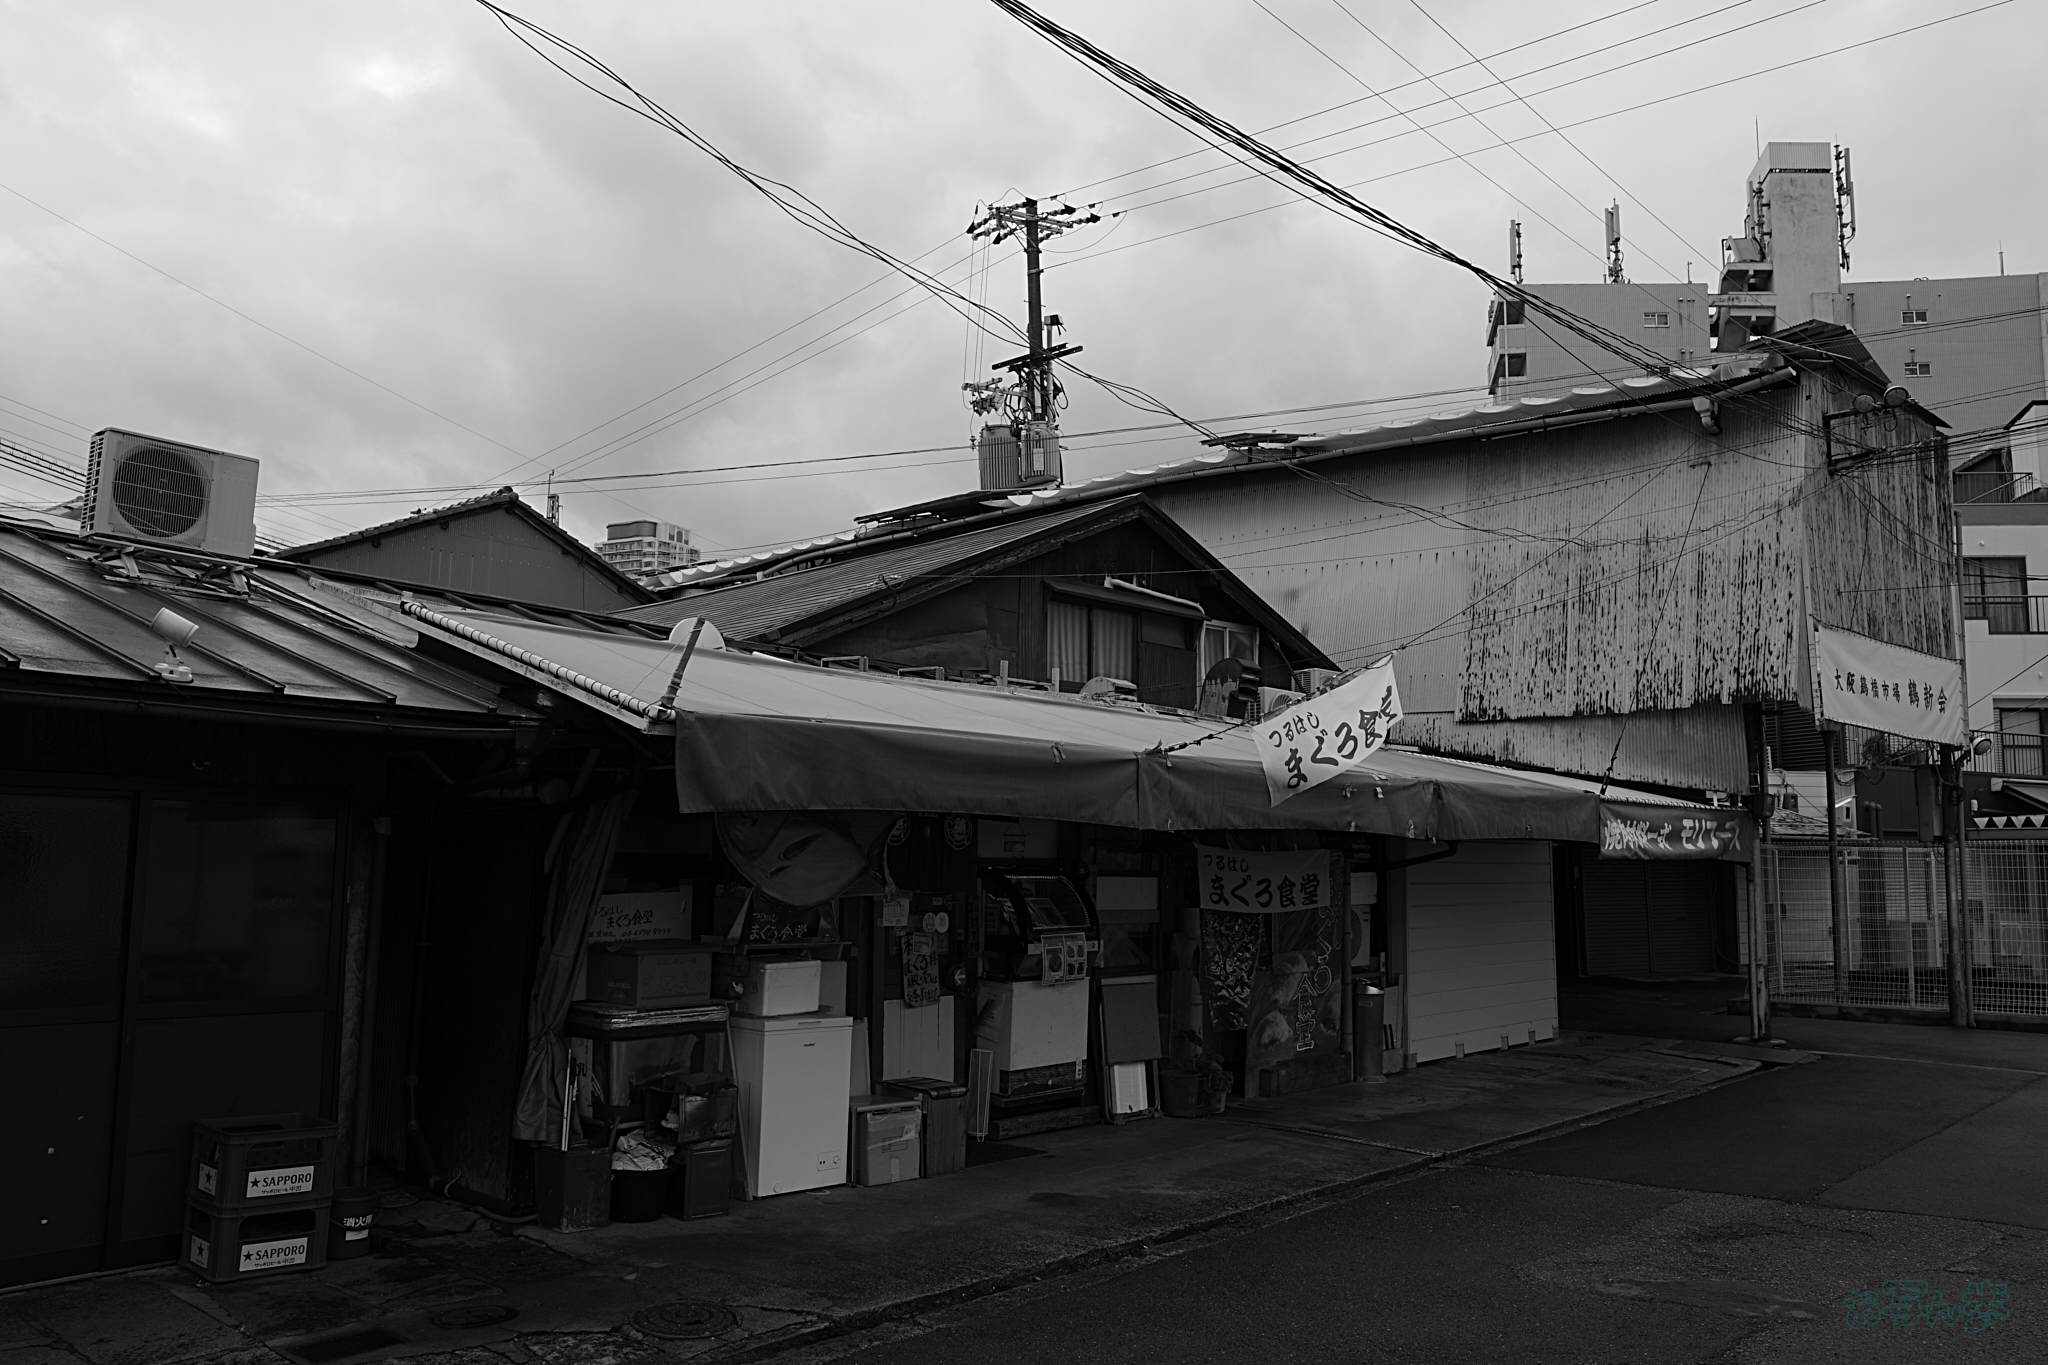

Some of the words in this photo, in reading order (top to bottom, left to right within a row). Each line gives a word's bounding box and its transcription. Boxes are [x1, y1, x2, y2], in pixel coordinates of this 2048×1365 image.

[1269, 712, 1319, 748] つるはし
[1204, 854, 1249, 873] つるはし
[1209, 873, 1320, 908] まぐろ食堂
[594, 905, 624, 918] るはし
[752, 912, 777, 922] つるはし
[749, 923, 808, 941] まぐろ食堂
[262, 1172, 312, 1188] SAPPORO
[343, 1213, 373, 1228] 消火用
[255, 1245, 306, 1261] SAPPORO
